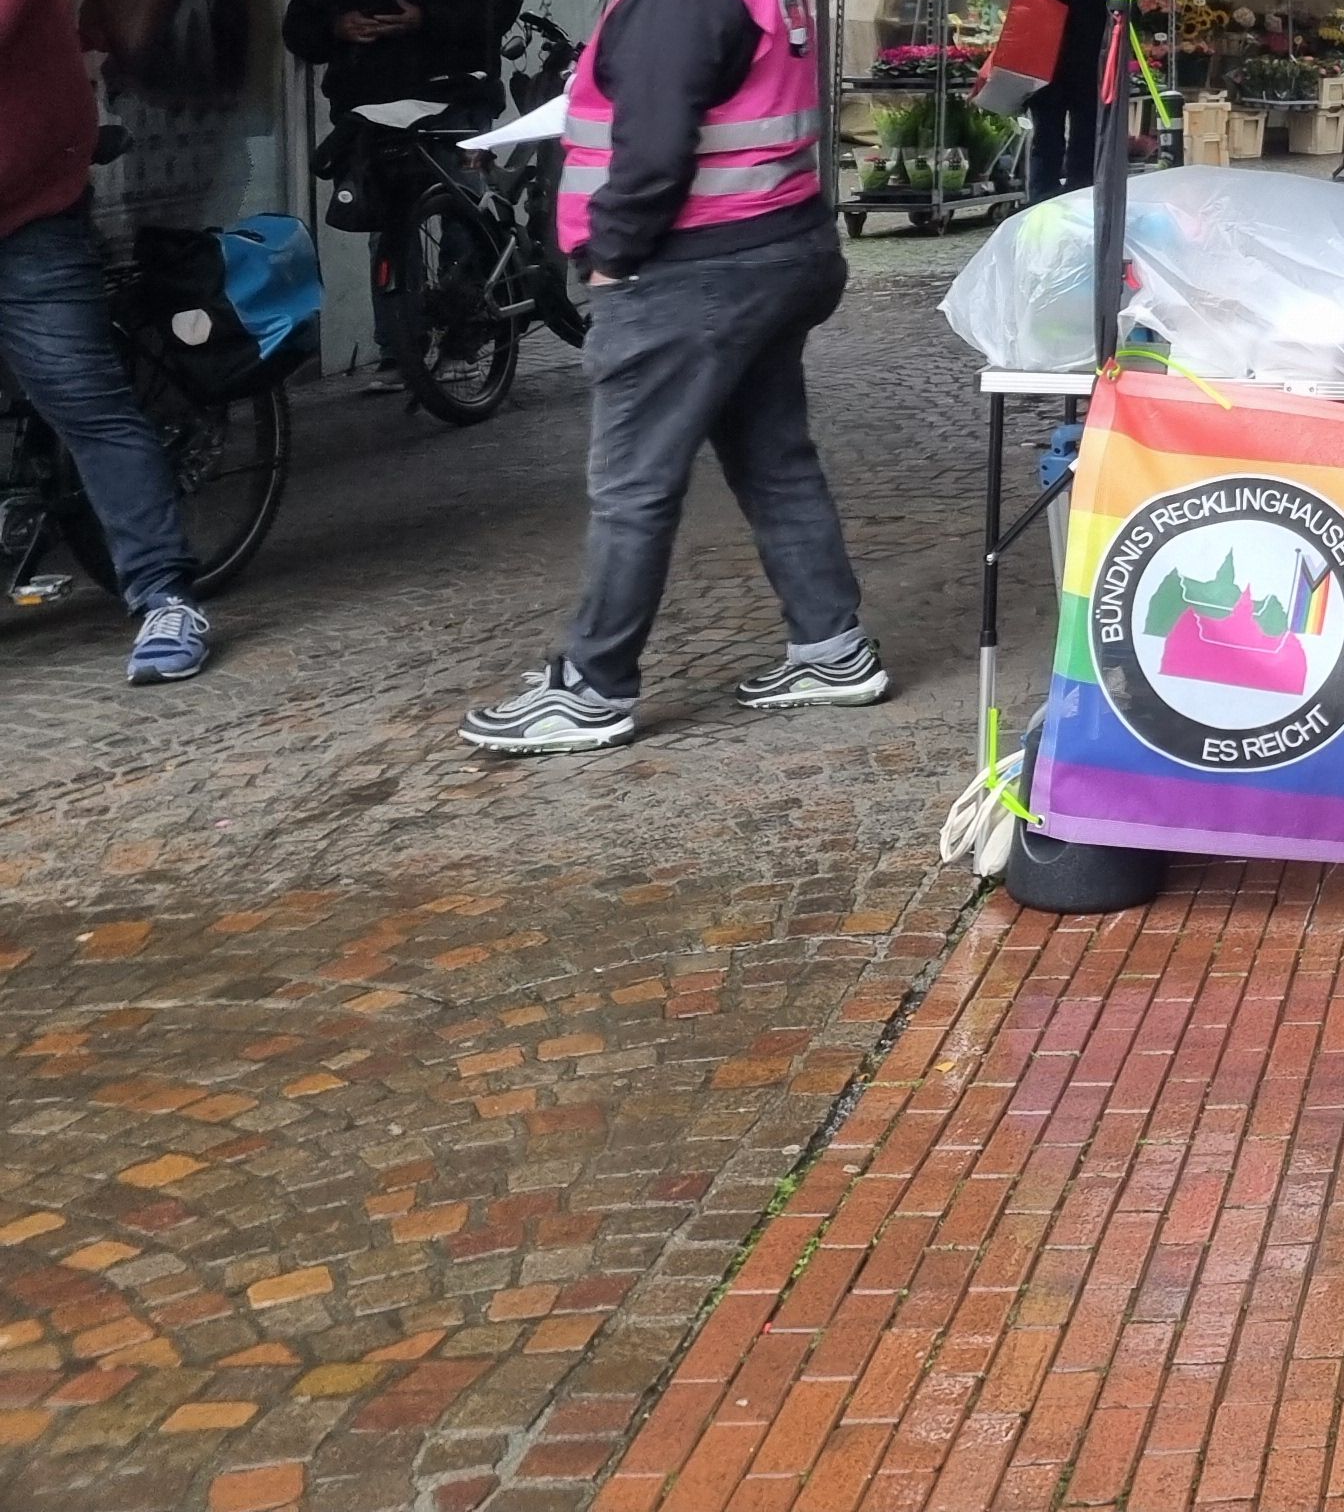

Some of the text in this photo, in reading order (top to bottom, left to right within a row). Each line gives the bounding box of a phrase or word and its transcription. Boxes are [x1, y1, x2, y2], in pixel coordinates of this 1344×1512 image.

[1095, 527, 1153, 643] BÜNDNIS
[1202, 703, 1330, 762] ES REICHT
